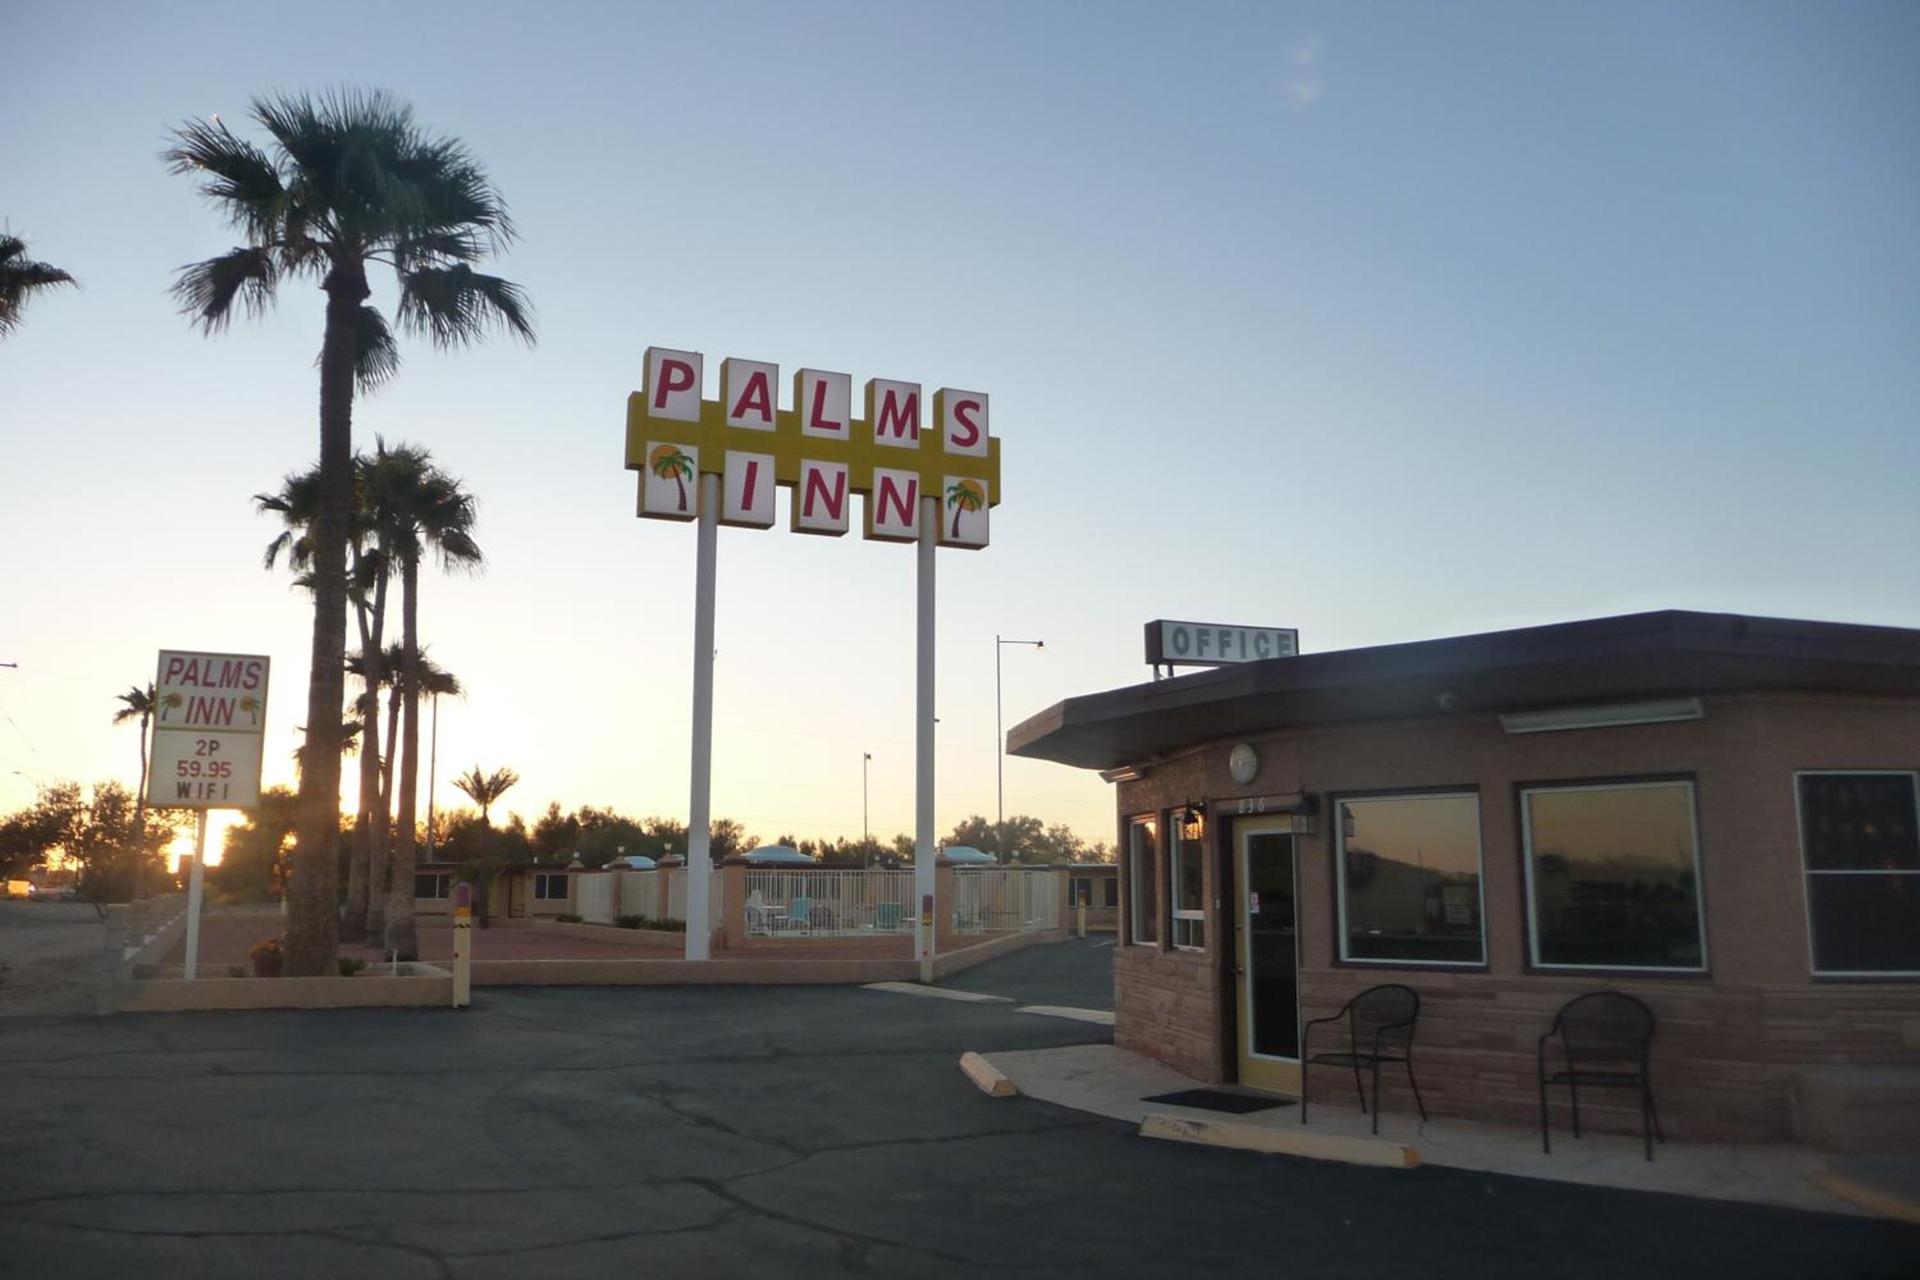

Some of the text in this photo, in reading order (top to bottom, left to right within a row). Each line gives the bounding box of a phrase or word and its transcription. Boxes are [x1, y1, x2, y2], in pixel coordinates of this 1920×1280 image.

[654, 358, 980, 448] PALMS
[741, 461, 918, 529] INN
[1171, 626, 1292, 659] OFFICE
[164, 657, 262, 690] PALMS
[185, 695, 236, 726] INN
[195, 739, 221, 757] 2P
[177, 760, 232, 779] 59.95
[177, 781, 229, 800] WIFI
